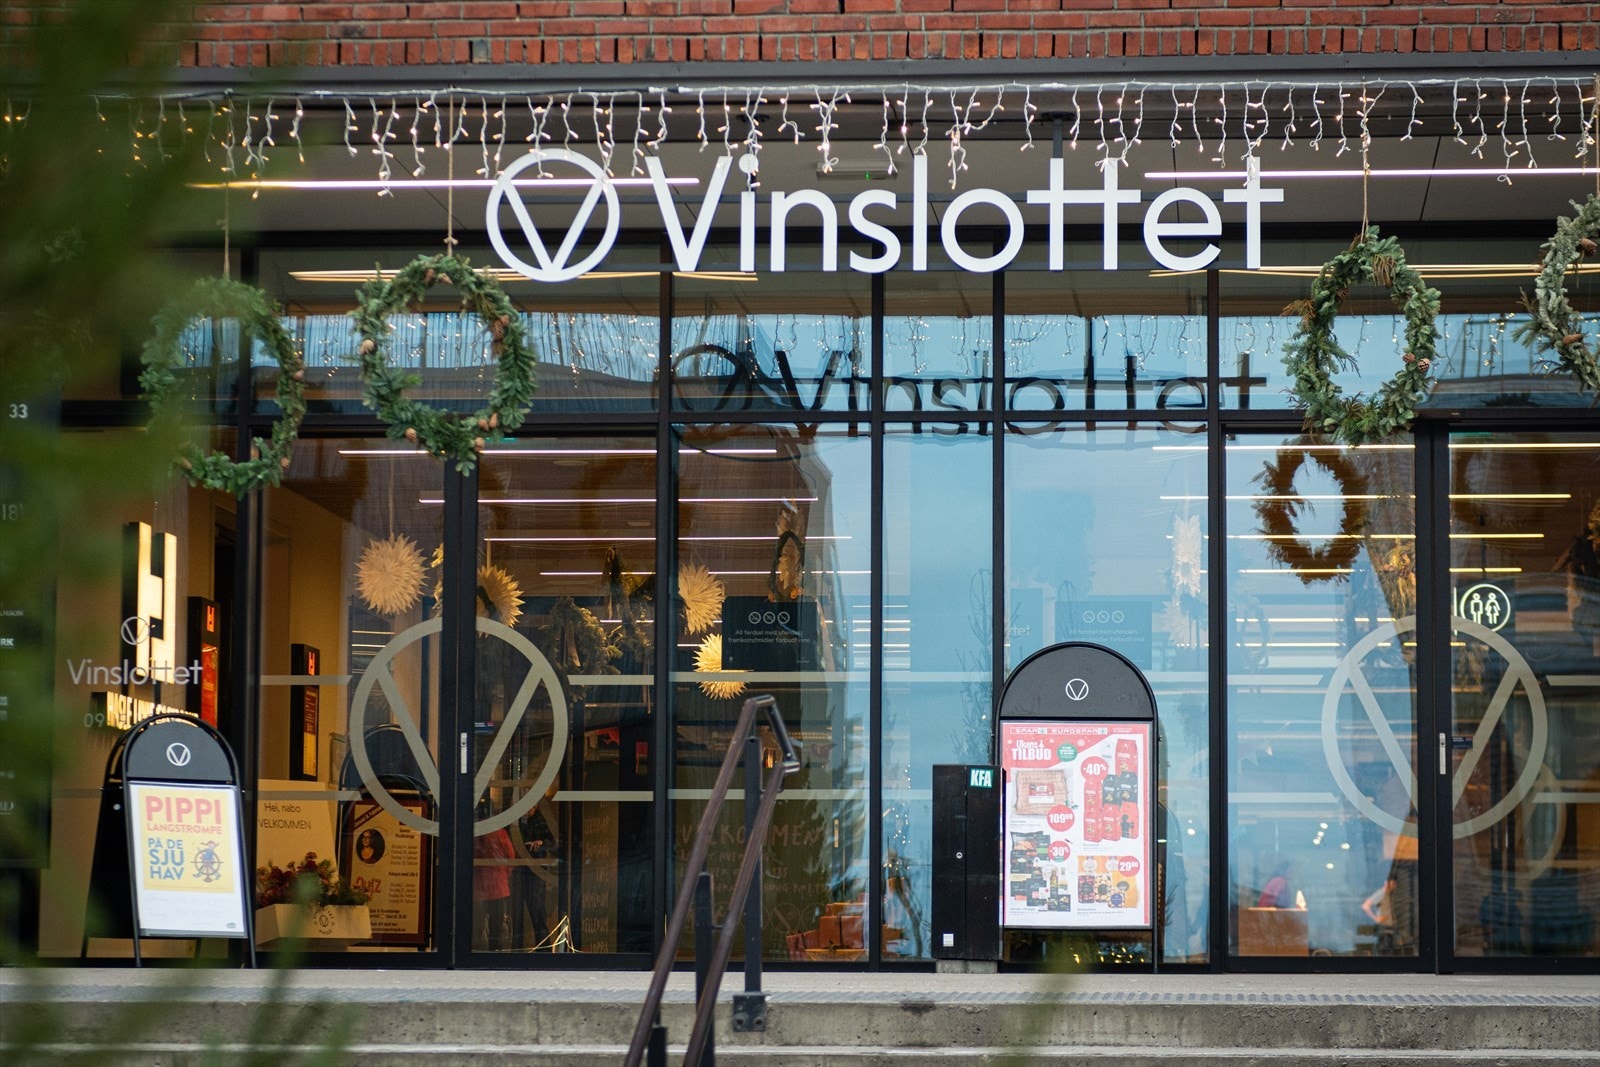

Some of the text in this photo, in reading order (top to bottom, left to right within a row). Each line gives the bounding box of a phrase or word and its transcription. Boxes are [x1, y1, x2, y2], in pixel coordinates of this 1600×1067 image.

[645, 154, 1285, 275] Vinslottet
[9, 403, 29, 419] 33
[67, 658, 204, 685] Vinslottet
[1011, 748, 1052, 760] TILBUD
[970, 769, 992, 787] KFA
[144, 795, 222, 825] PIPPI
[264, 802, 281, 813] Hei,
[258, 818, 311, 830] VELKOMMEN
[147, 837, 183, 850] PÅ DE
[149, 848, 185, 866] SJU
[149, 865, 185, 880] HAV
